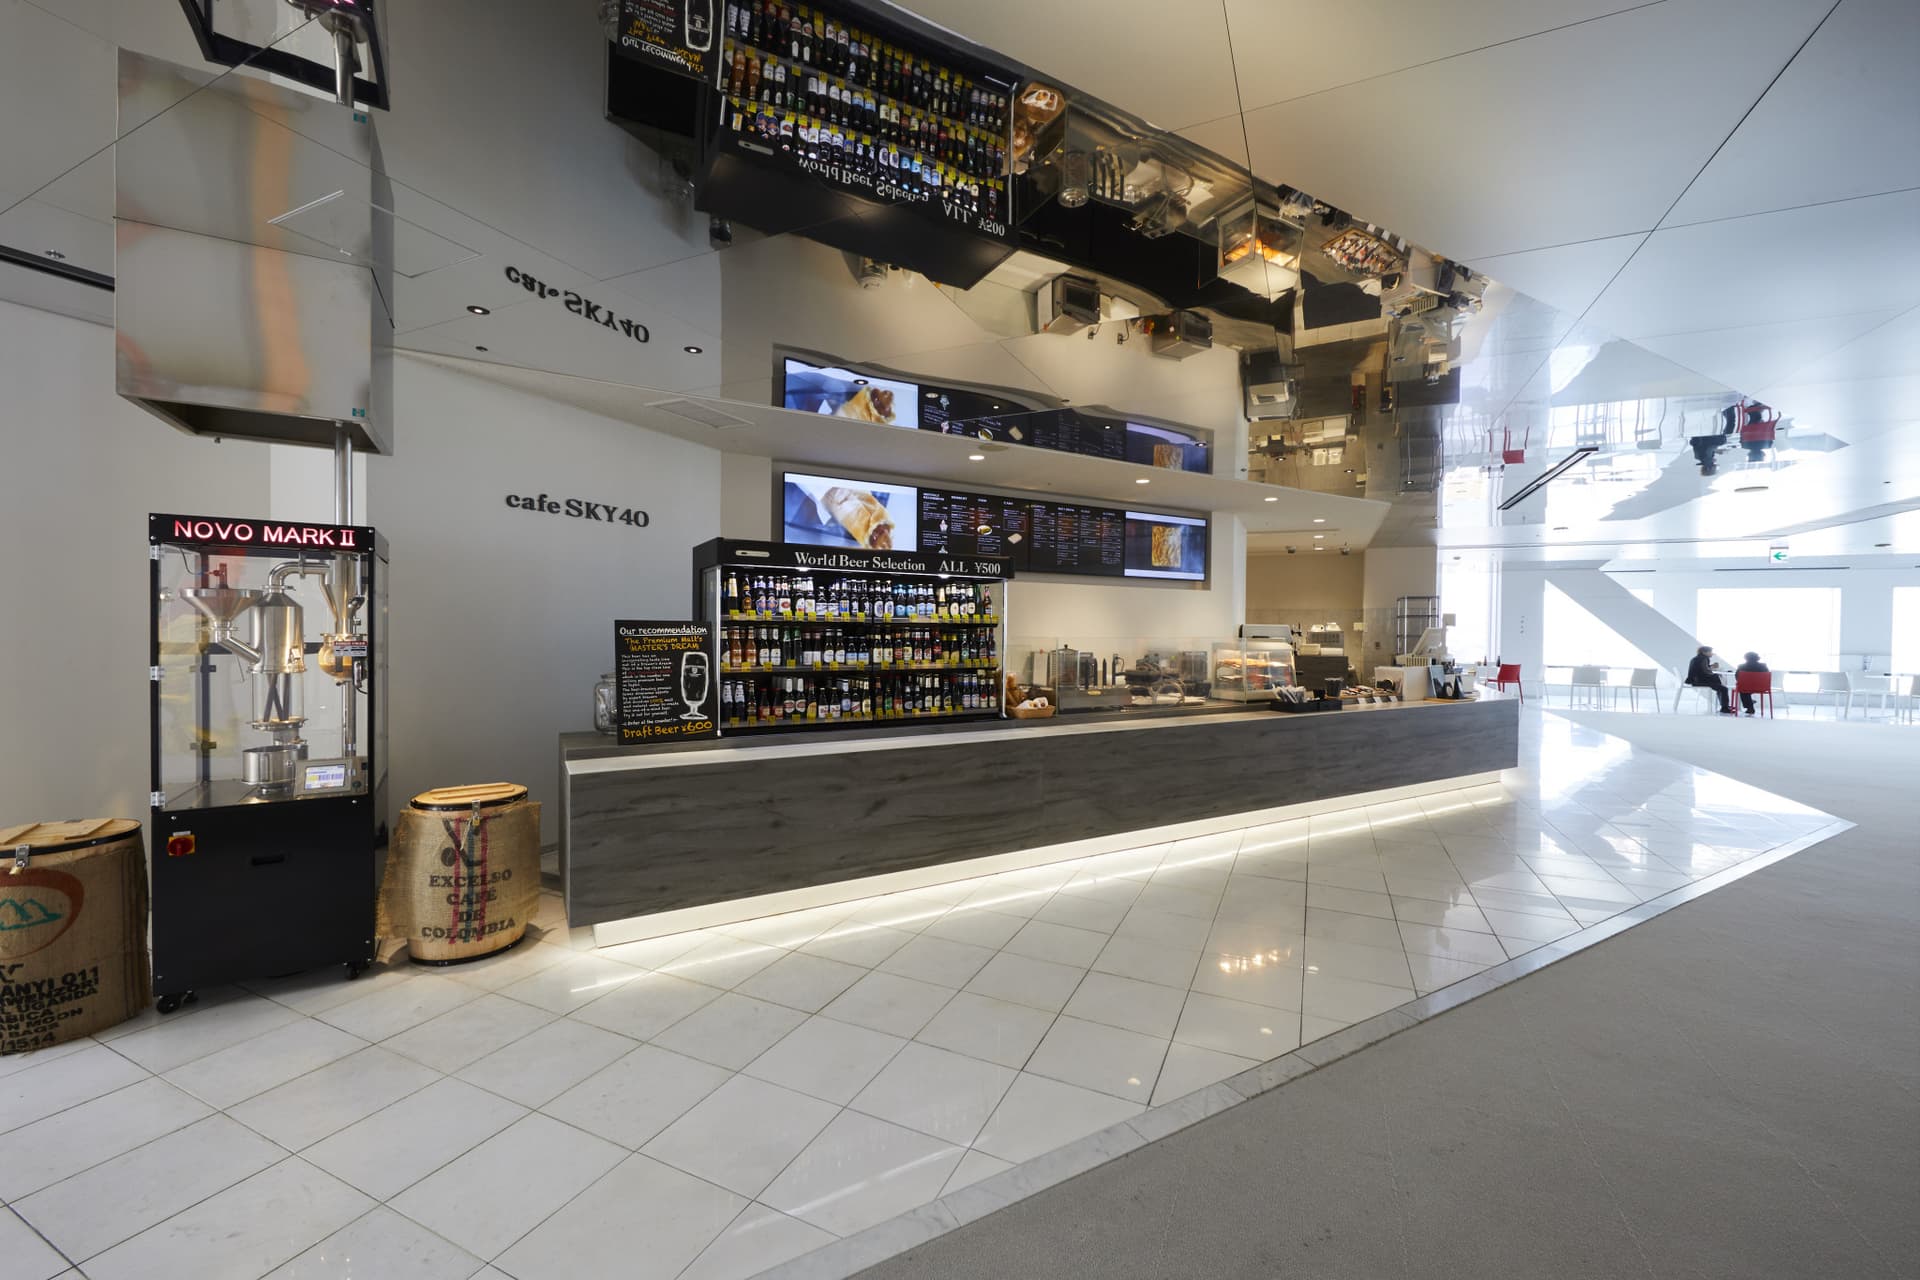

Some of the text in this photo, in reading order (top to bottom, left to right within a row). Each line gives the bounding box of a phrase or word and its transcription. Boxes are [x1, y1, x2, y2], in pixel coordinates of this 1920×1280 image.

[174, 520, 253, 541] NOVO
[263, 526, 335, 546] MARK
[795, 551, 836, 567] World
[839, 555, 869, 568] Beer
[872, 556, 926, 571] Selection
[939, 560, 968, 573] ALL
[620, 625, 708, 635] Our recommendation
[671, 642, 700, 650] DREAM
[623, 726, 652, 738] Draft
[655, 725, 679, 734] Beer
[429, 869, 513, 888] EXCELSO
[422, 918, 516, 939] COLOMBIA
